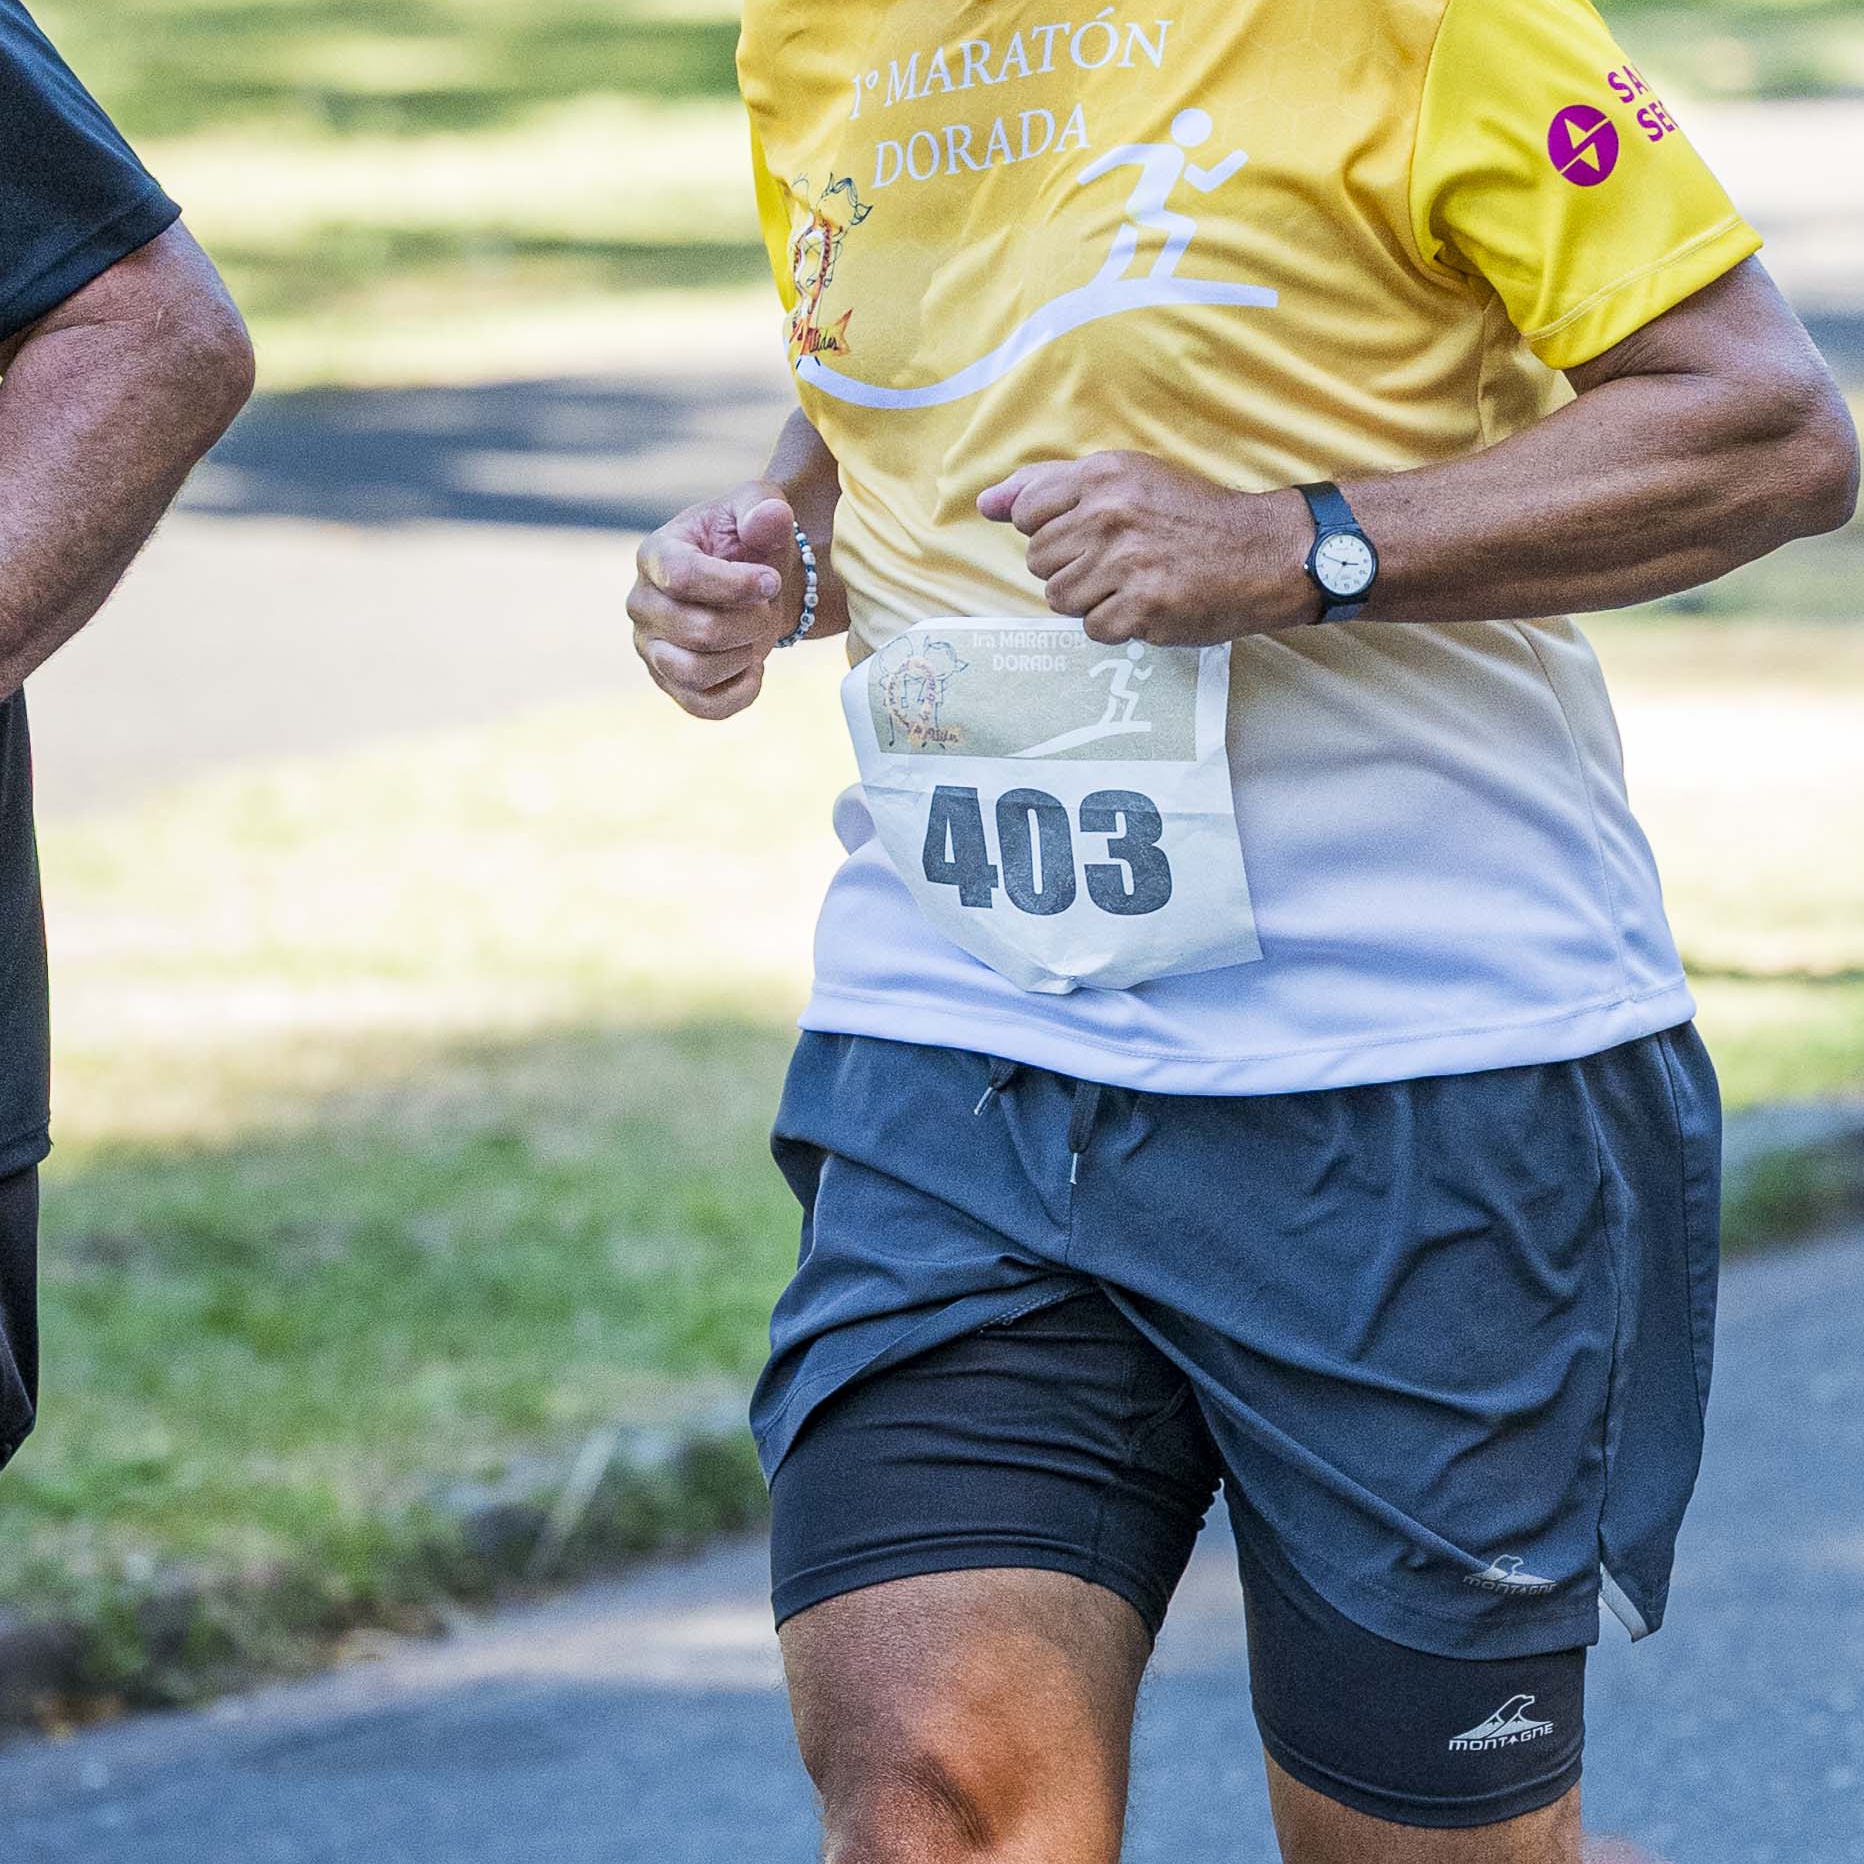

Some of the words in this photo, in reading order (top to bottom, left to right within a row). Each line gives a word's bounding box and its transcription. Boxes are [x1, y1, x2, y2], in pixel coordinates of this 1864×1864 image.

[884, 5, 1174, 108] MARATÓN
[1607, 64, 1650, 104] SA
[870, 102, 1092, 189] DORADA
[1636, 99, 1680, 143] SE
[992, 653, 1066, 673] DORADA
[921, 784, 1174, 917] 403
